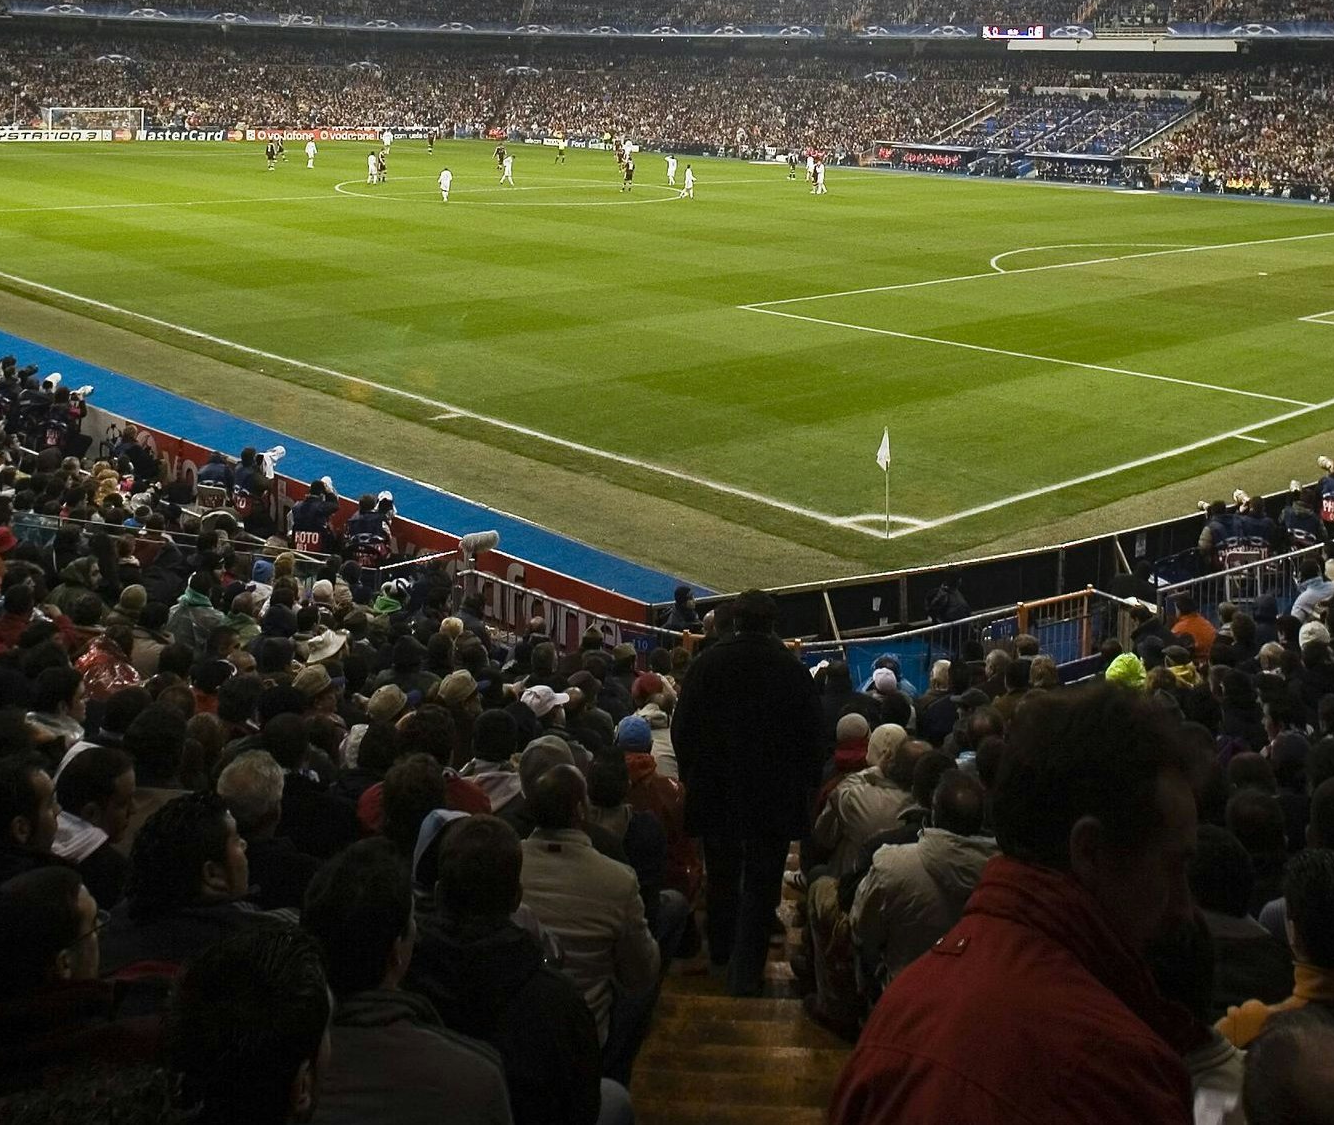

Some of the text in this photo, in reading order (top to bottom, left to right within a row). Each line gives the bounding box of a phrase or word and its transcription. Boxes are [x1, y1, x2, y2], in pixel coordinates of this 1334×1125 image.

[84, 132, 97, 142] 3
[135, 130, 224, 141] MasterCard
[571, 140, 586, 148] Ford
